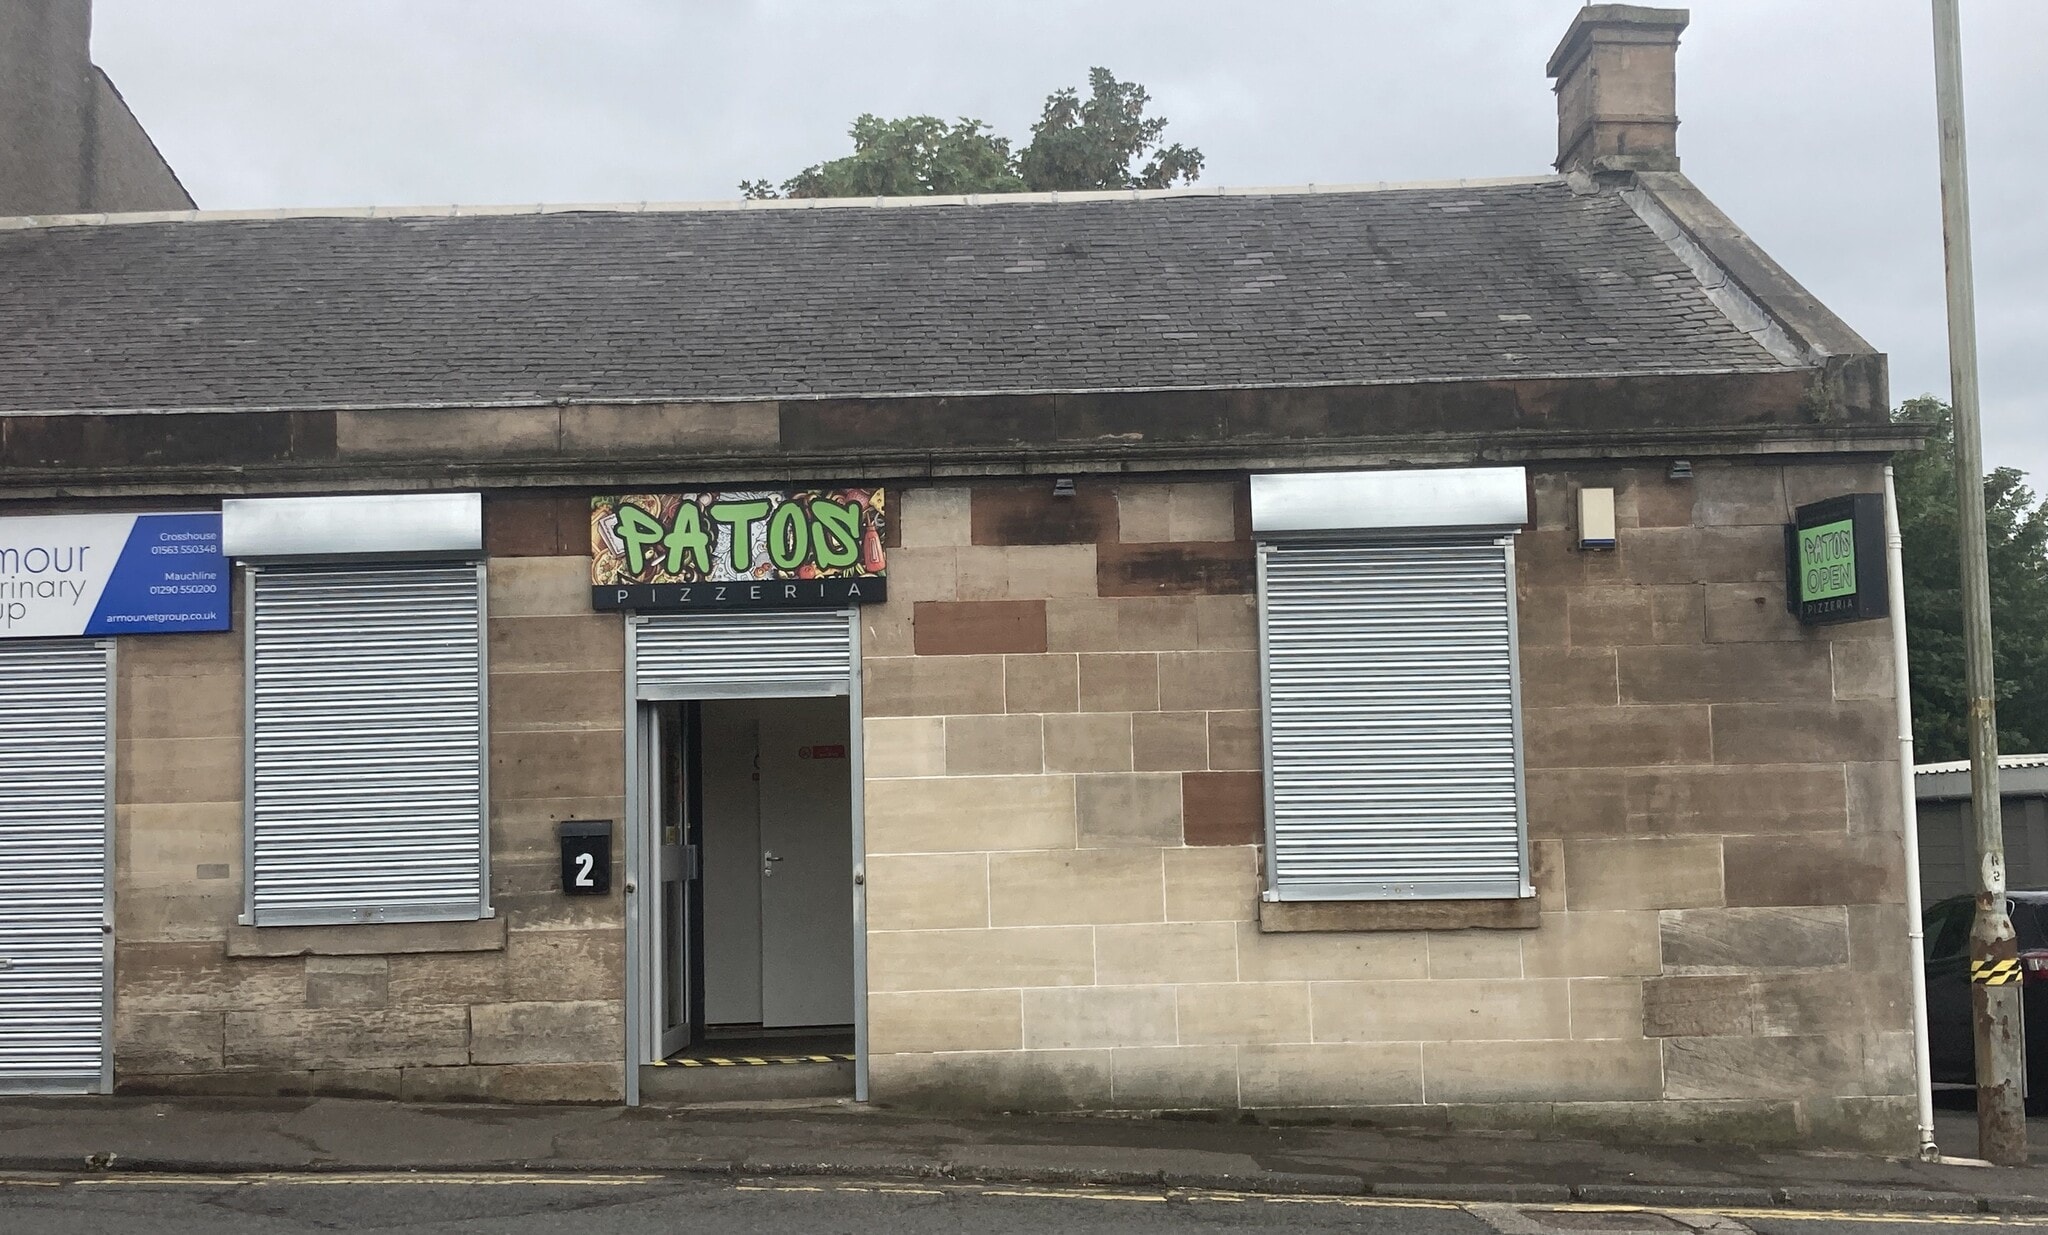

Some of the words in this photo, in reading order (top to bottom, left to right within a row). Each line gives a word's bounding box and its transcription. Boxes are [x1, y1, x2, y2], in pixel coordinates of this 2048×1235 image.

[159, 531, 217, 542] Crosshouse
[614, 499, 861, 576] PATOS
[151, 545, 179, 555] 01563
[181, 544, 217, 554] 550348
[1804, 529, 1851, 565] PATOS
[165, 571, 217, 581] Mauchline
[1807, 562, 1853, 594] OPEN
[0, 576, 87, 606] rinary
[150, 585, 178, 595] 01290
[179, 584, 217, 594] 550200
[617, 582, 861, 604] PIZZERIA
[1807, 599, 1853, 614] PIZZERIA
[106, 611, 217, 625] armourvetgroup.co.uk
[575, 852, 594, 887] 2
[1993, 870, 2000, 882] 2
